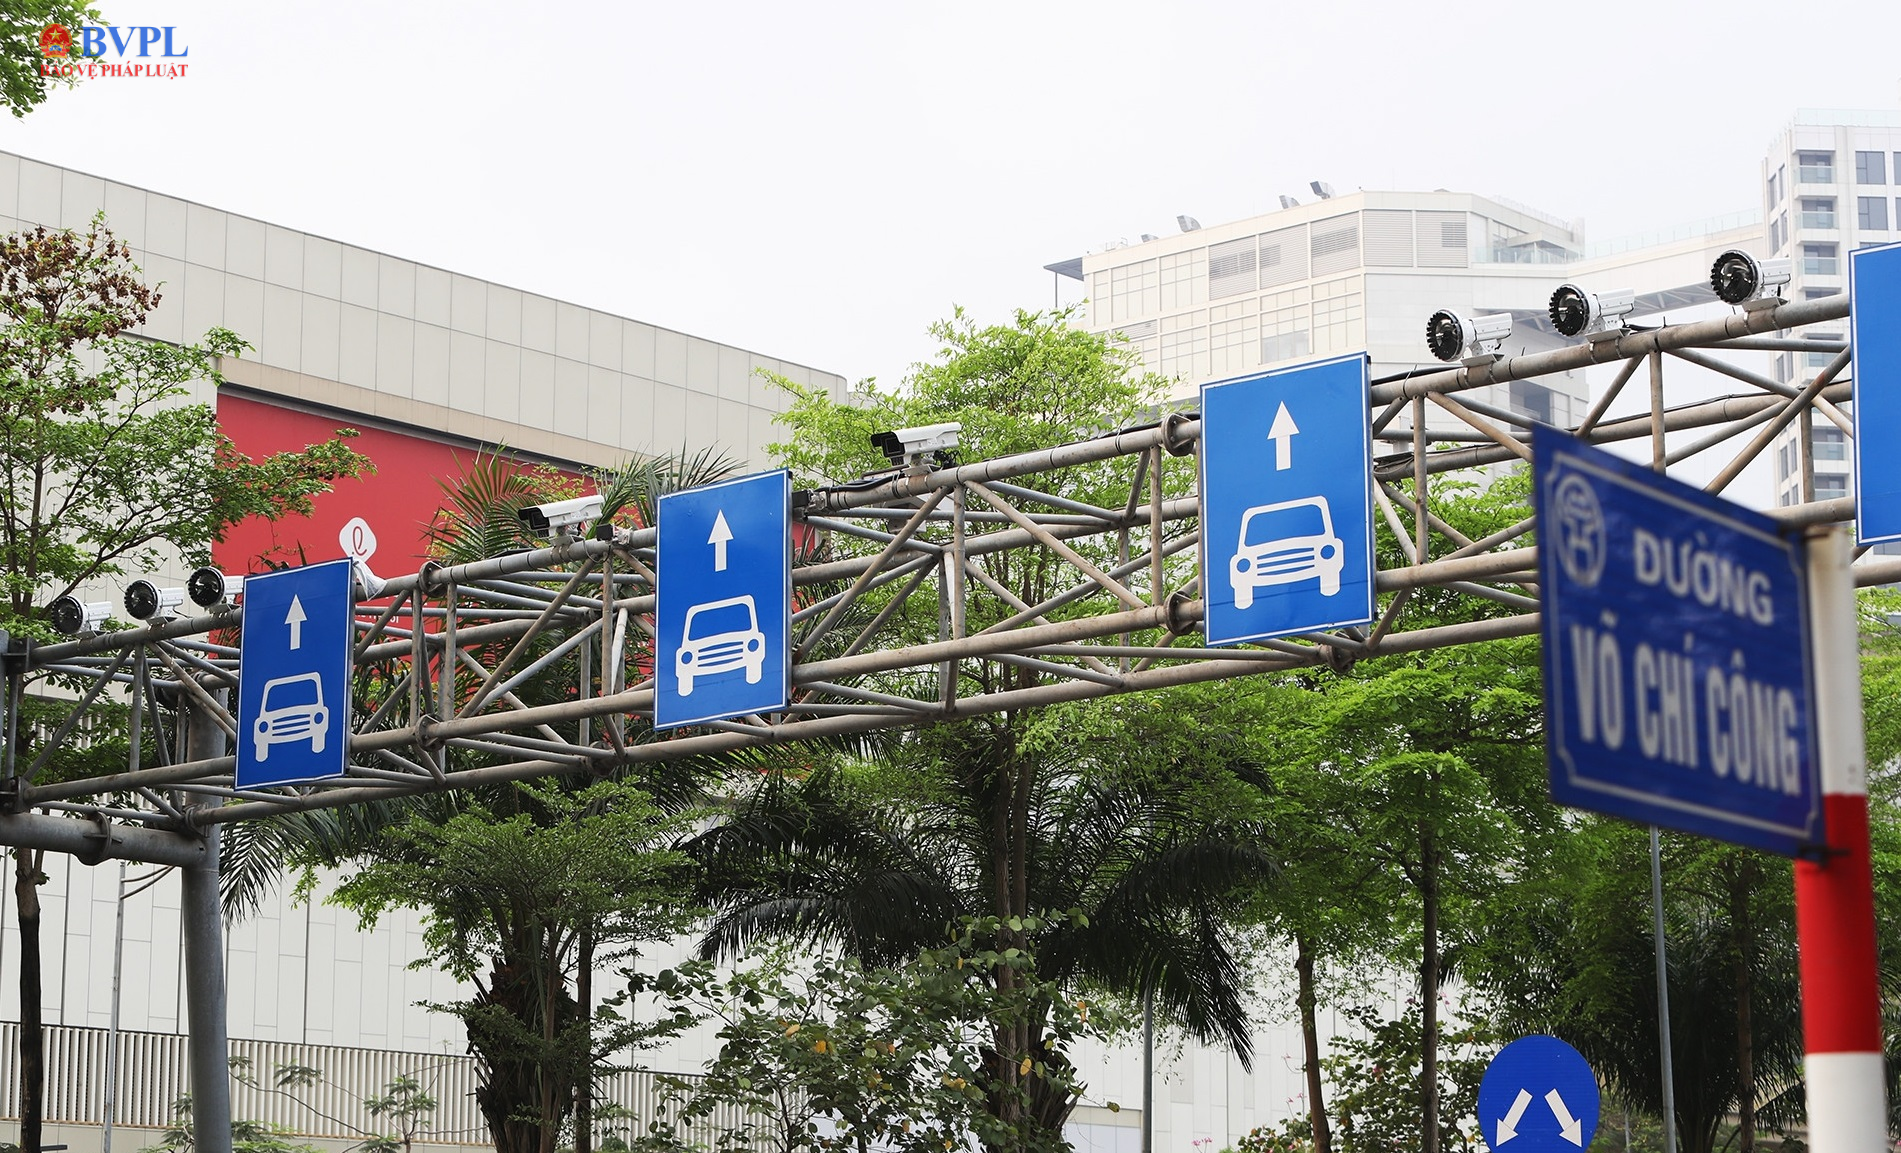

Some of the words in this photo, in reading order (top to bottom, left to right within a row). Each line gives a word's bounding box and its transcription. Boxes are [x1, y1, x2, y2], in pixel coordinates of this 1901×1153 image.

[1633, 529, 1773, 626] ĐƯỜNG
[1570, 609, 1626, 750] VÕ
[1632, 631, 1698, 769] CHÍ
[1705, 648, 1801, 797] CÔNG
